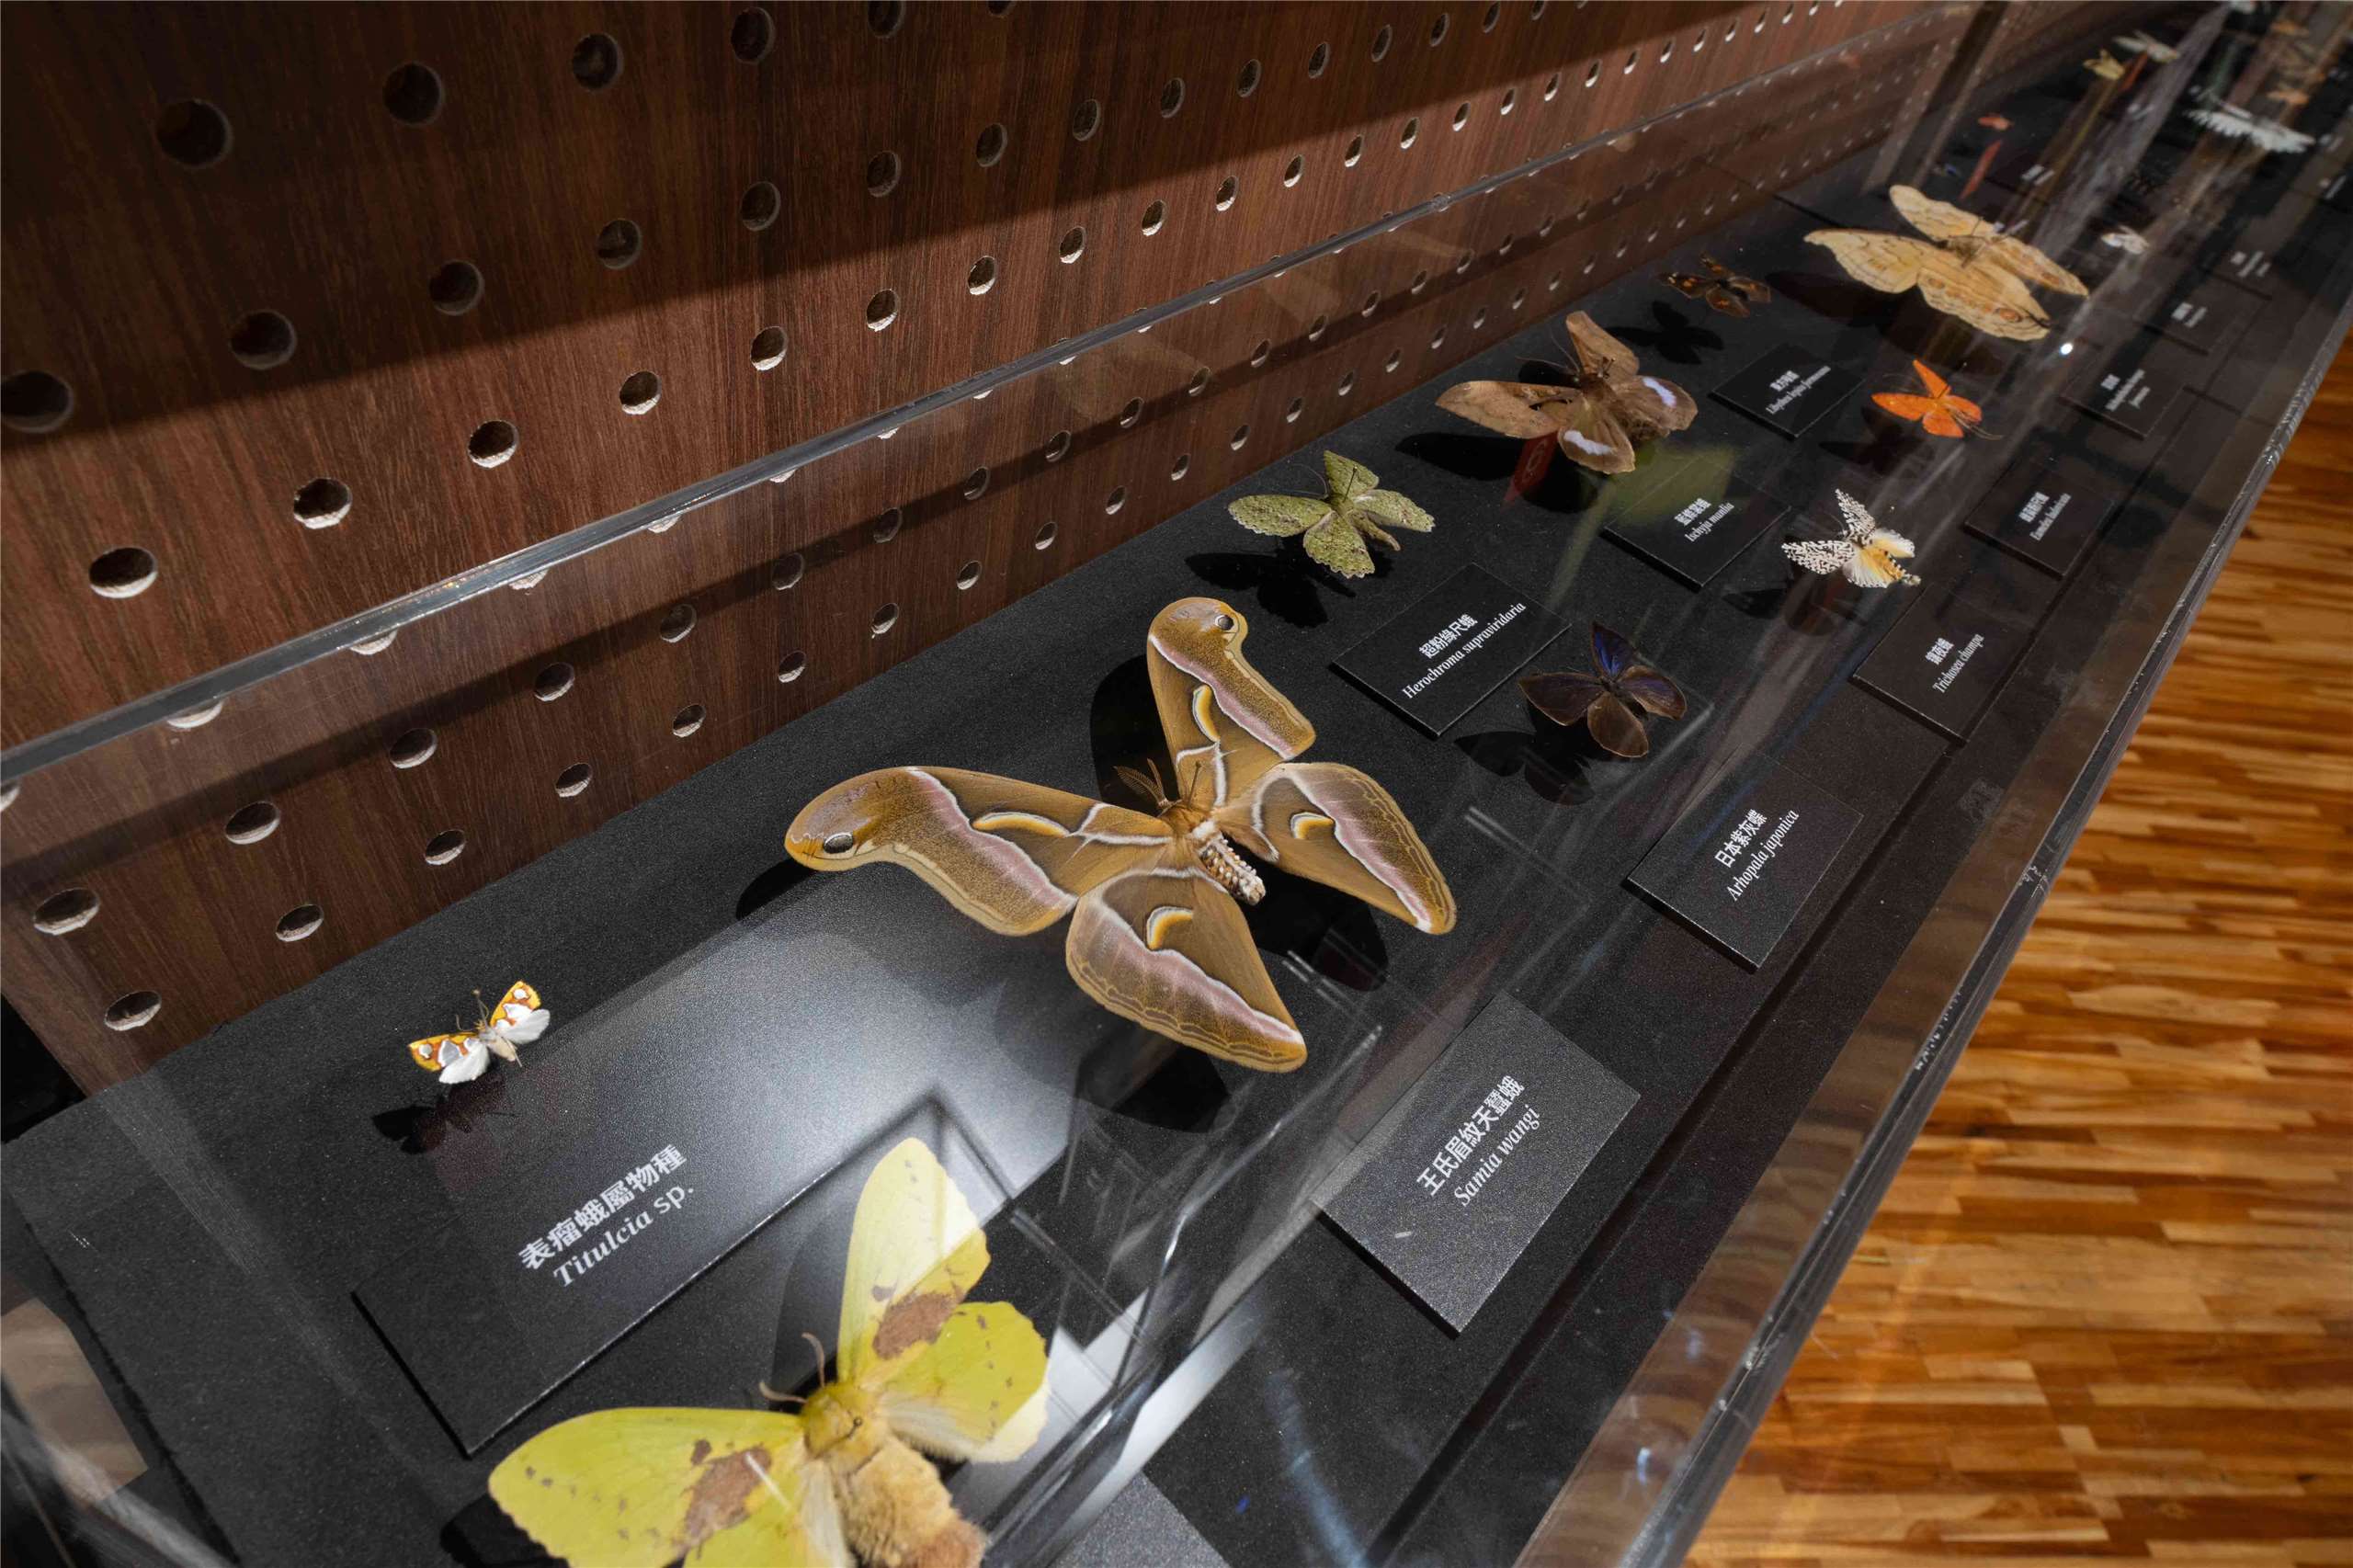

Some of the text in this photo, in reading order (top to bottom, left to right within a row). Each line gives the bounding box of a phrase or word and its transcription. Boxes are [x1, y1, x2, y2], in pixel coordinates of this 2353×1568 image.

[1402, 602, 1527, 699] Herochroma supraviridaria
[1714, 809, 1768, 868] 日本紫灰蝶
[1726, 810, 1800, 902] Arhopala japonica
[1416, 1075, 1526, 1196] 王氏眉紋天蠶蛾
[1454, 1104, 1540, 1207] Samia wangi
[518, 1144, 688, 1270] 表瘤蛾屬物種
[553, 1186, 694, 1287] Titulcia sp.
